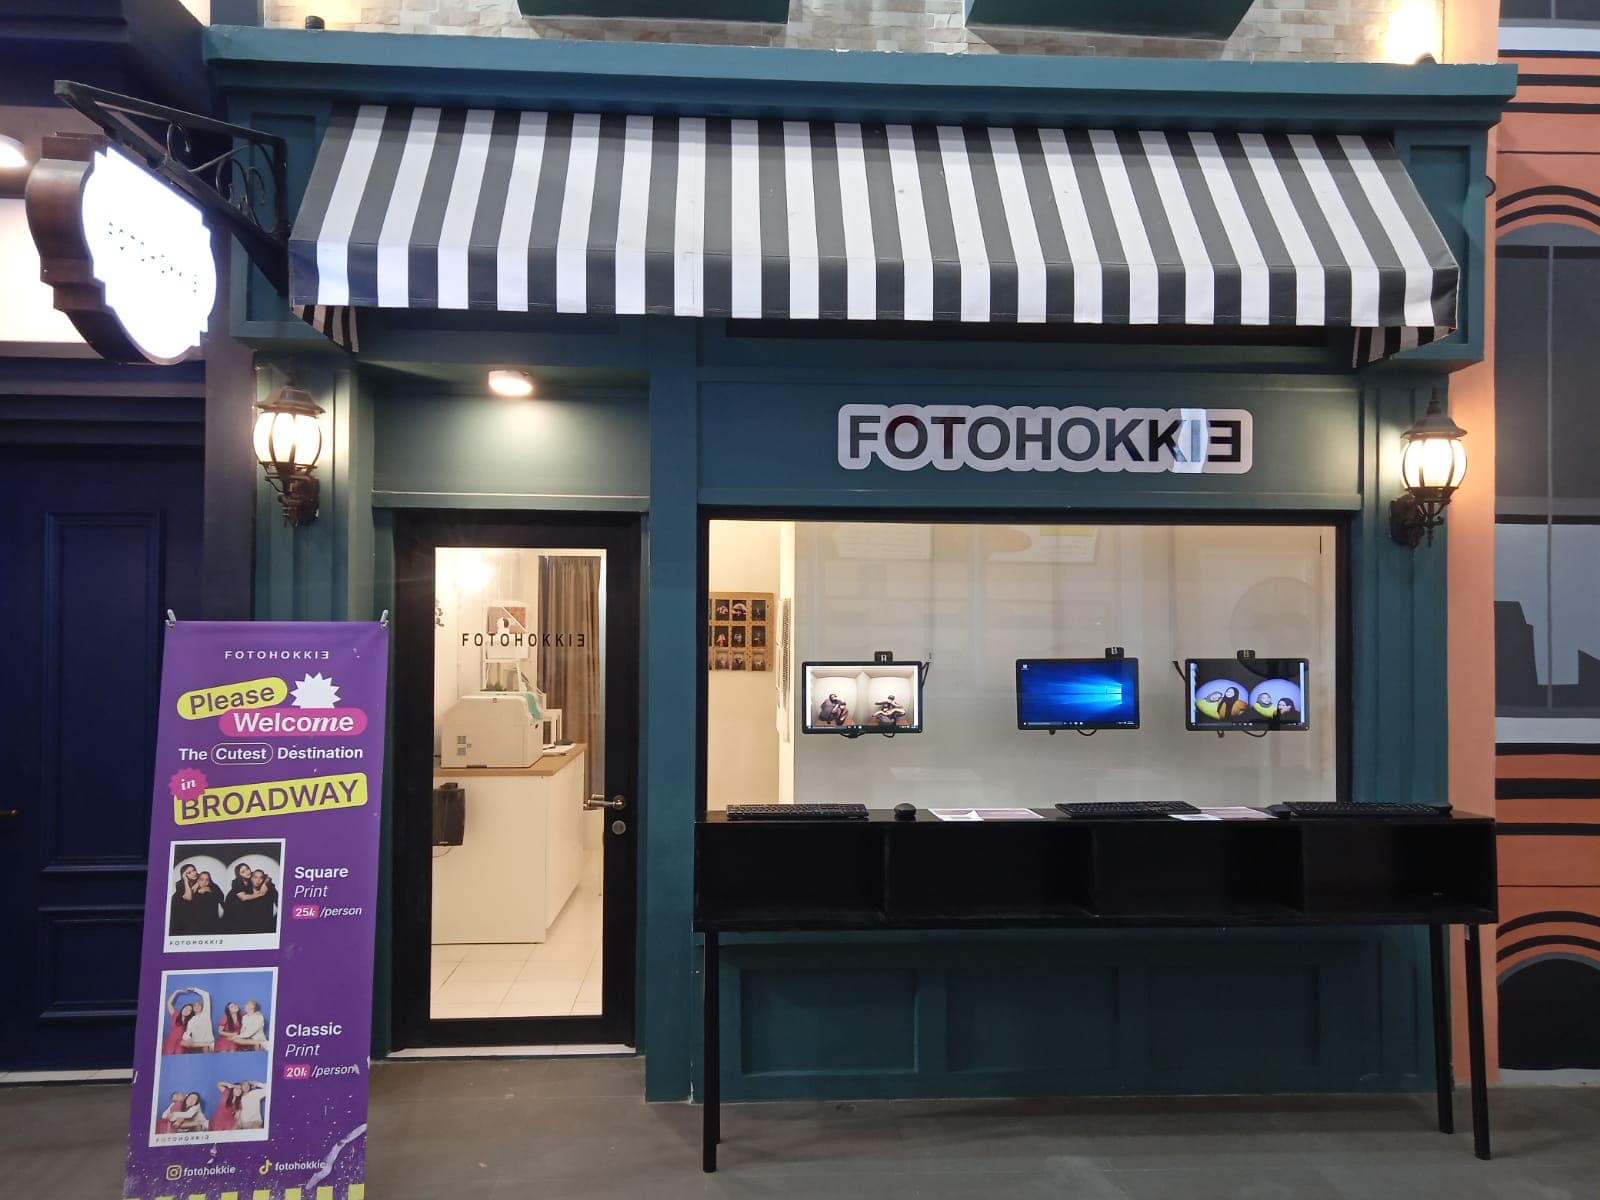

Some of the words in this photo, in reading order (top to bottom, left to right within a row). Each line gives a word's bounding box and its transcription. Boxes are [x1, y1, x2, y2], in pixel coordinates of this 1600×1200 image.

[190, 686, 275, 715] Please
[233, 712, 354, 732] Welcome
[178, 748, 208, 761] The
[215, 748, 267, 760] Cutest
[278, 746, 364, 759] Destination
[181, 778, 196, 791] in
[181, 779, 359, 821] BROADWAY
[294, 866, 349, 881] Square
[294, 885, 328, 898] Print
[295, 907, 315, 917] 25k
[319, 906, 362, 918] /person
[285, 1022, 342, 1037] Classic
[285, 1043, 320, 1057] Print
[286, 1067, 307, 1077] 20k
[183, 1164, 236, 1177] fotohokkie
[275, 1160, 326, 1171] fotohokkie
